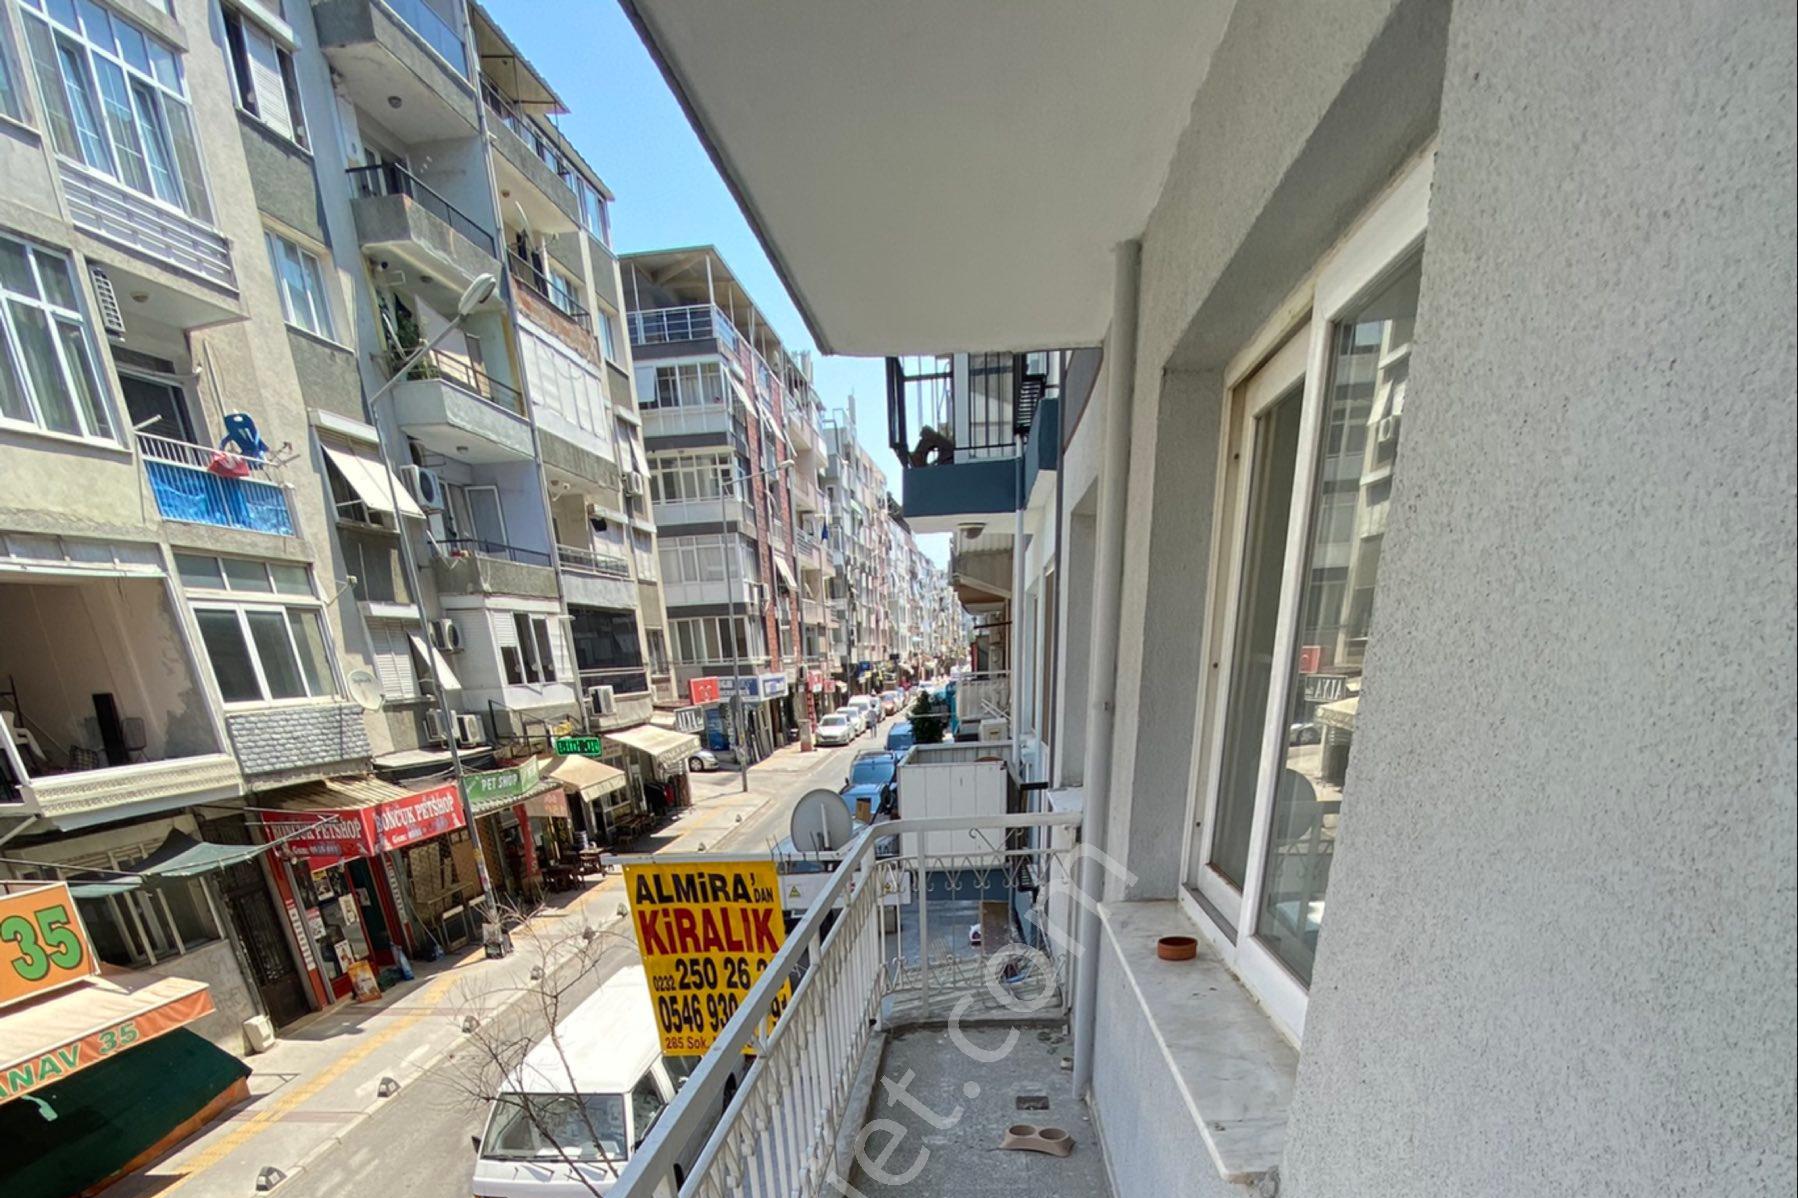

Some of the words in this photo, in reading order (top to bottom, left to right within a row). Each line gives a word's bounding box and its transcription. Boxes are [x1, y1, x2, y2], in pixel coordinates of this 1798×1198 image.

[481, 777, 496, 792] PET
[416, 794, 454, 822] PETSHOP
[0, 904, 83, 982] 35
[653, 975, 677, 992] 0232
[675, 957, 717, 991] 250
[723, 957, 751, 990] 26
[658, 994, 704, 1034] 0546
[0, 1043, 81, 1098] NAV
[99, 1023, 139, 1053] 35
